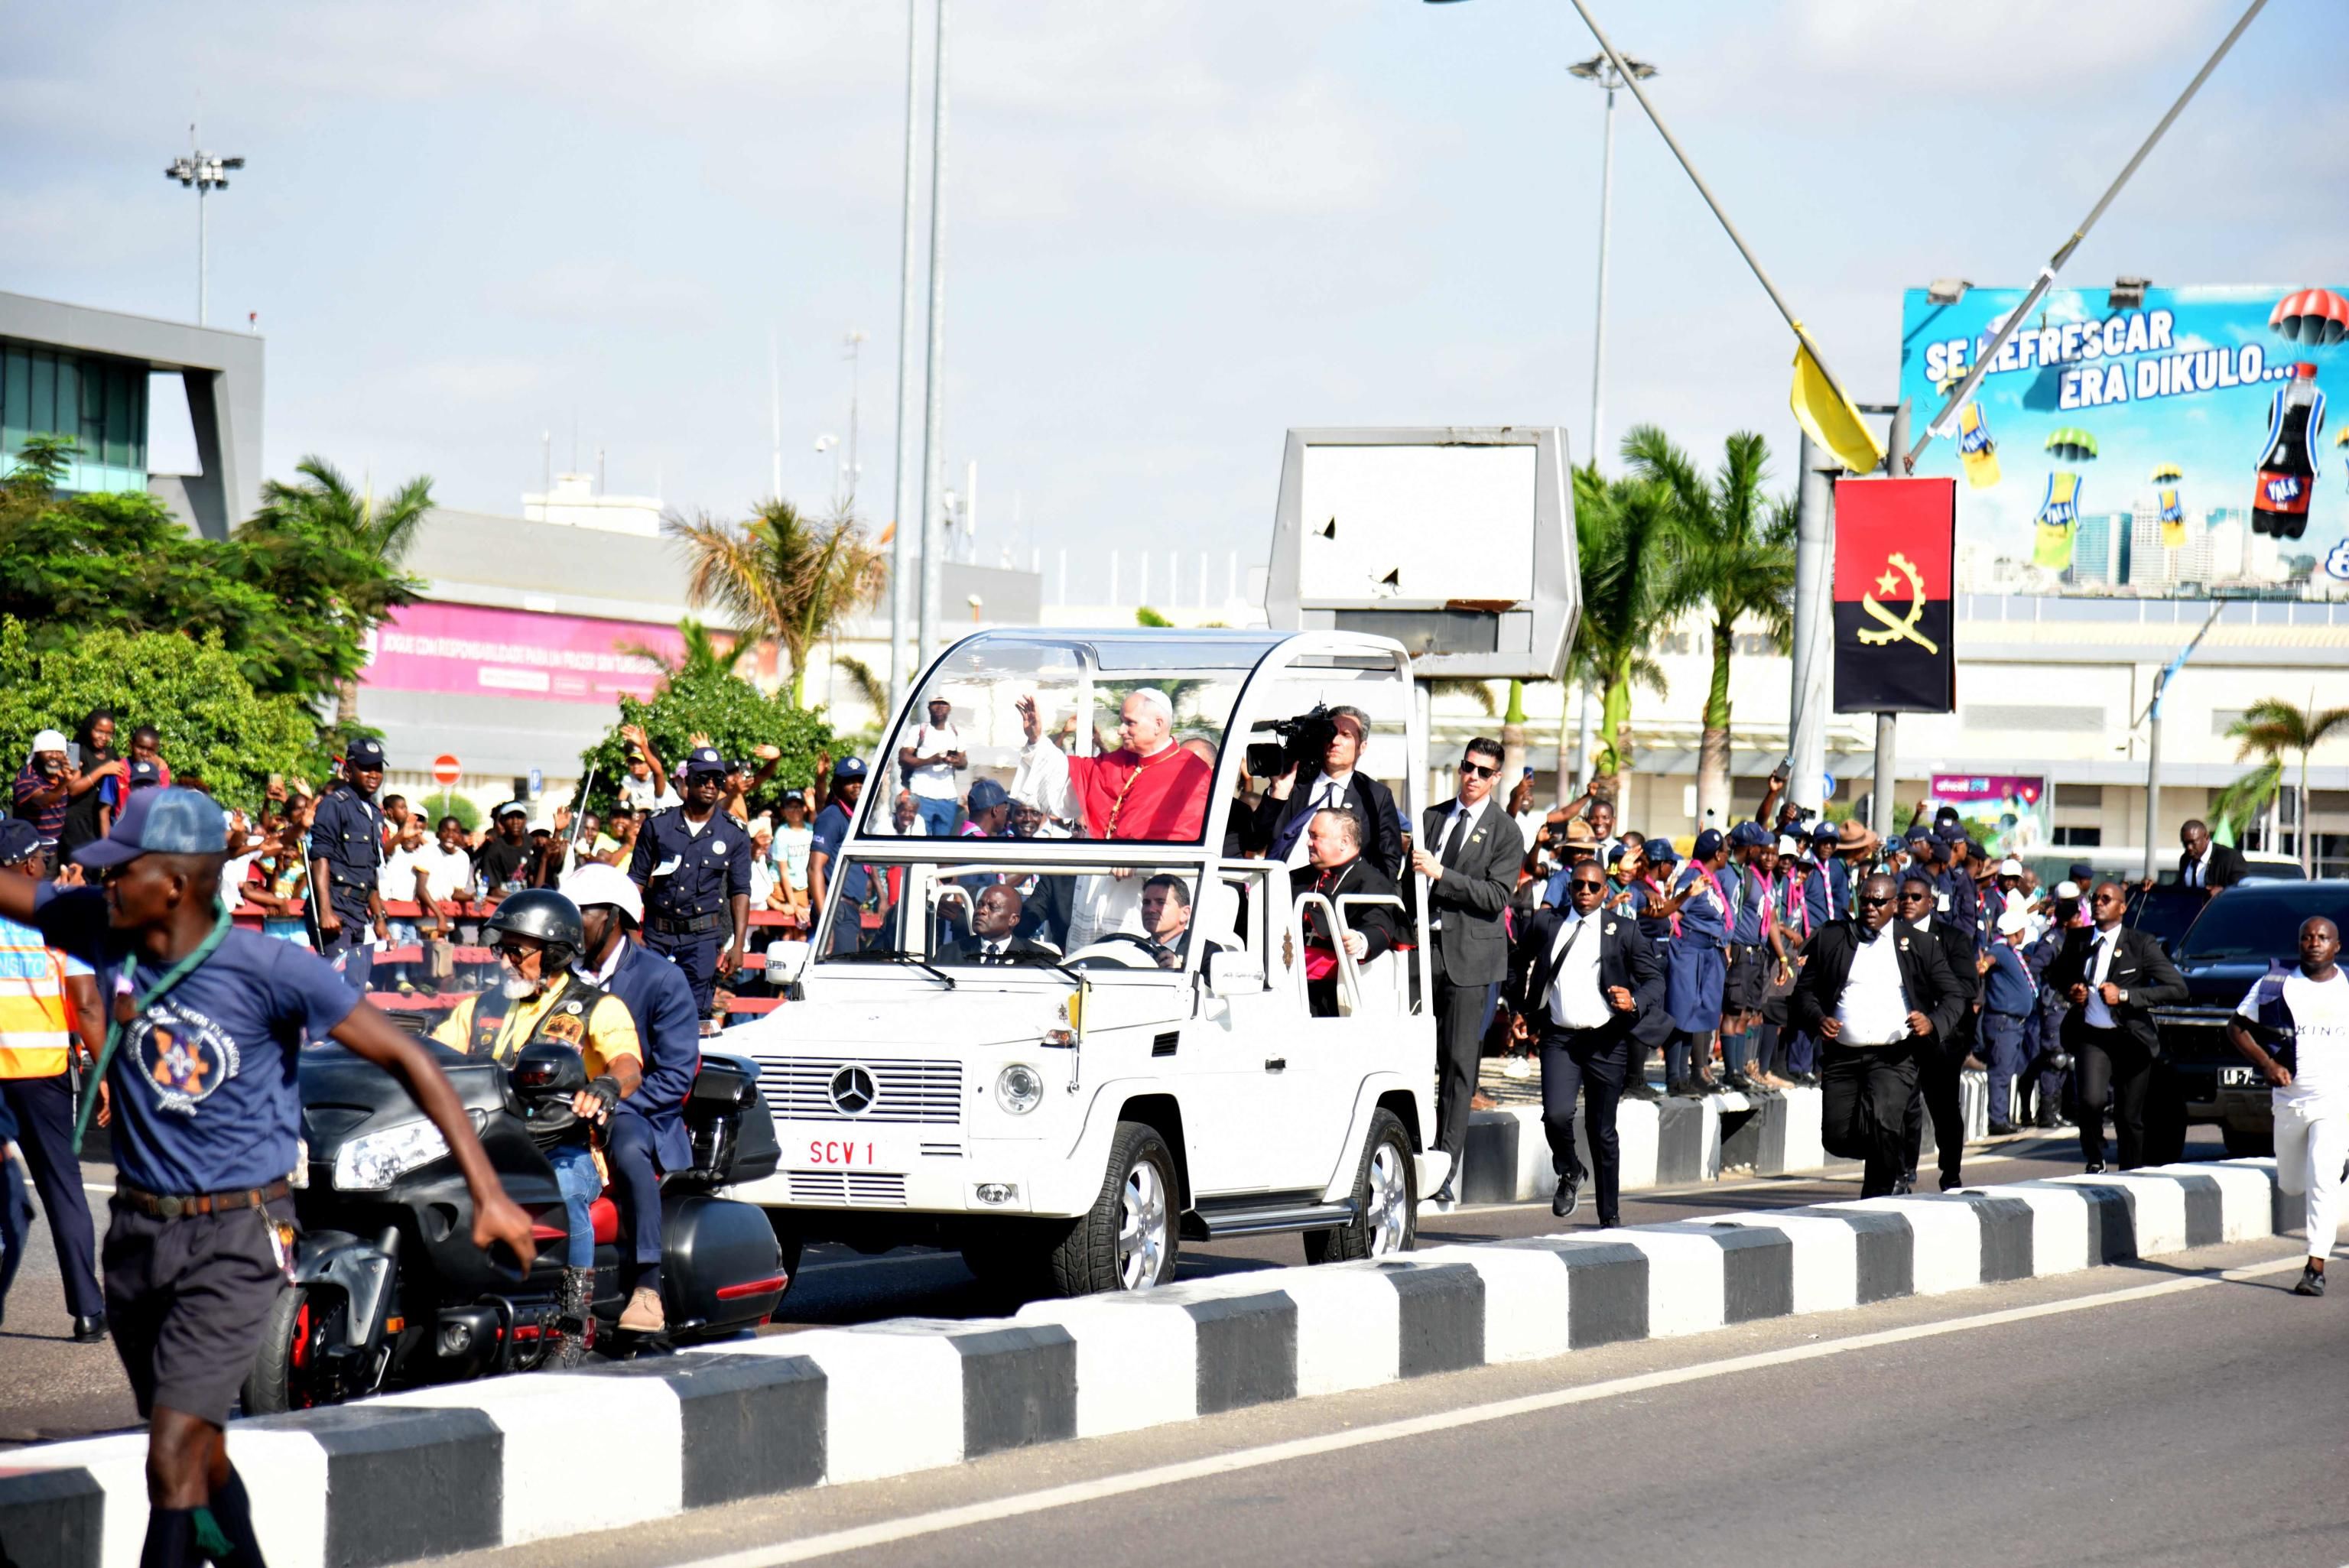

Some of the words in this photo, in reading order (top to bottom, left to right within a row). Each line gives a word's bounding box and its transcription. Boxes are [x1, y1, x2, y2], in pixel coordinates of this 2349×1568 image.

[1925, 338, 1968, 382] SE
[2059, 363, 2129, 411] ERA
[2136, 344, 2297, 400] DIKULO...
[2267, 477, 2299, 502] YALA
[221, 1036, 240, 1078] ANGOLA
[811, 1141, 854, 1164] SCV
[867, 1142, 872, 1165] 1
